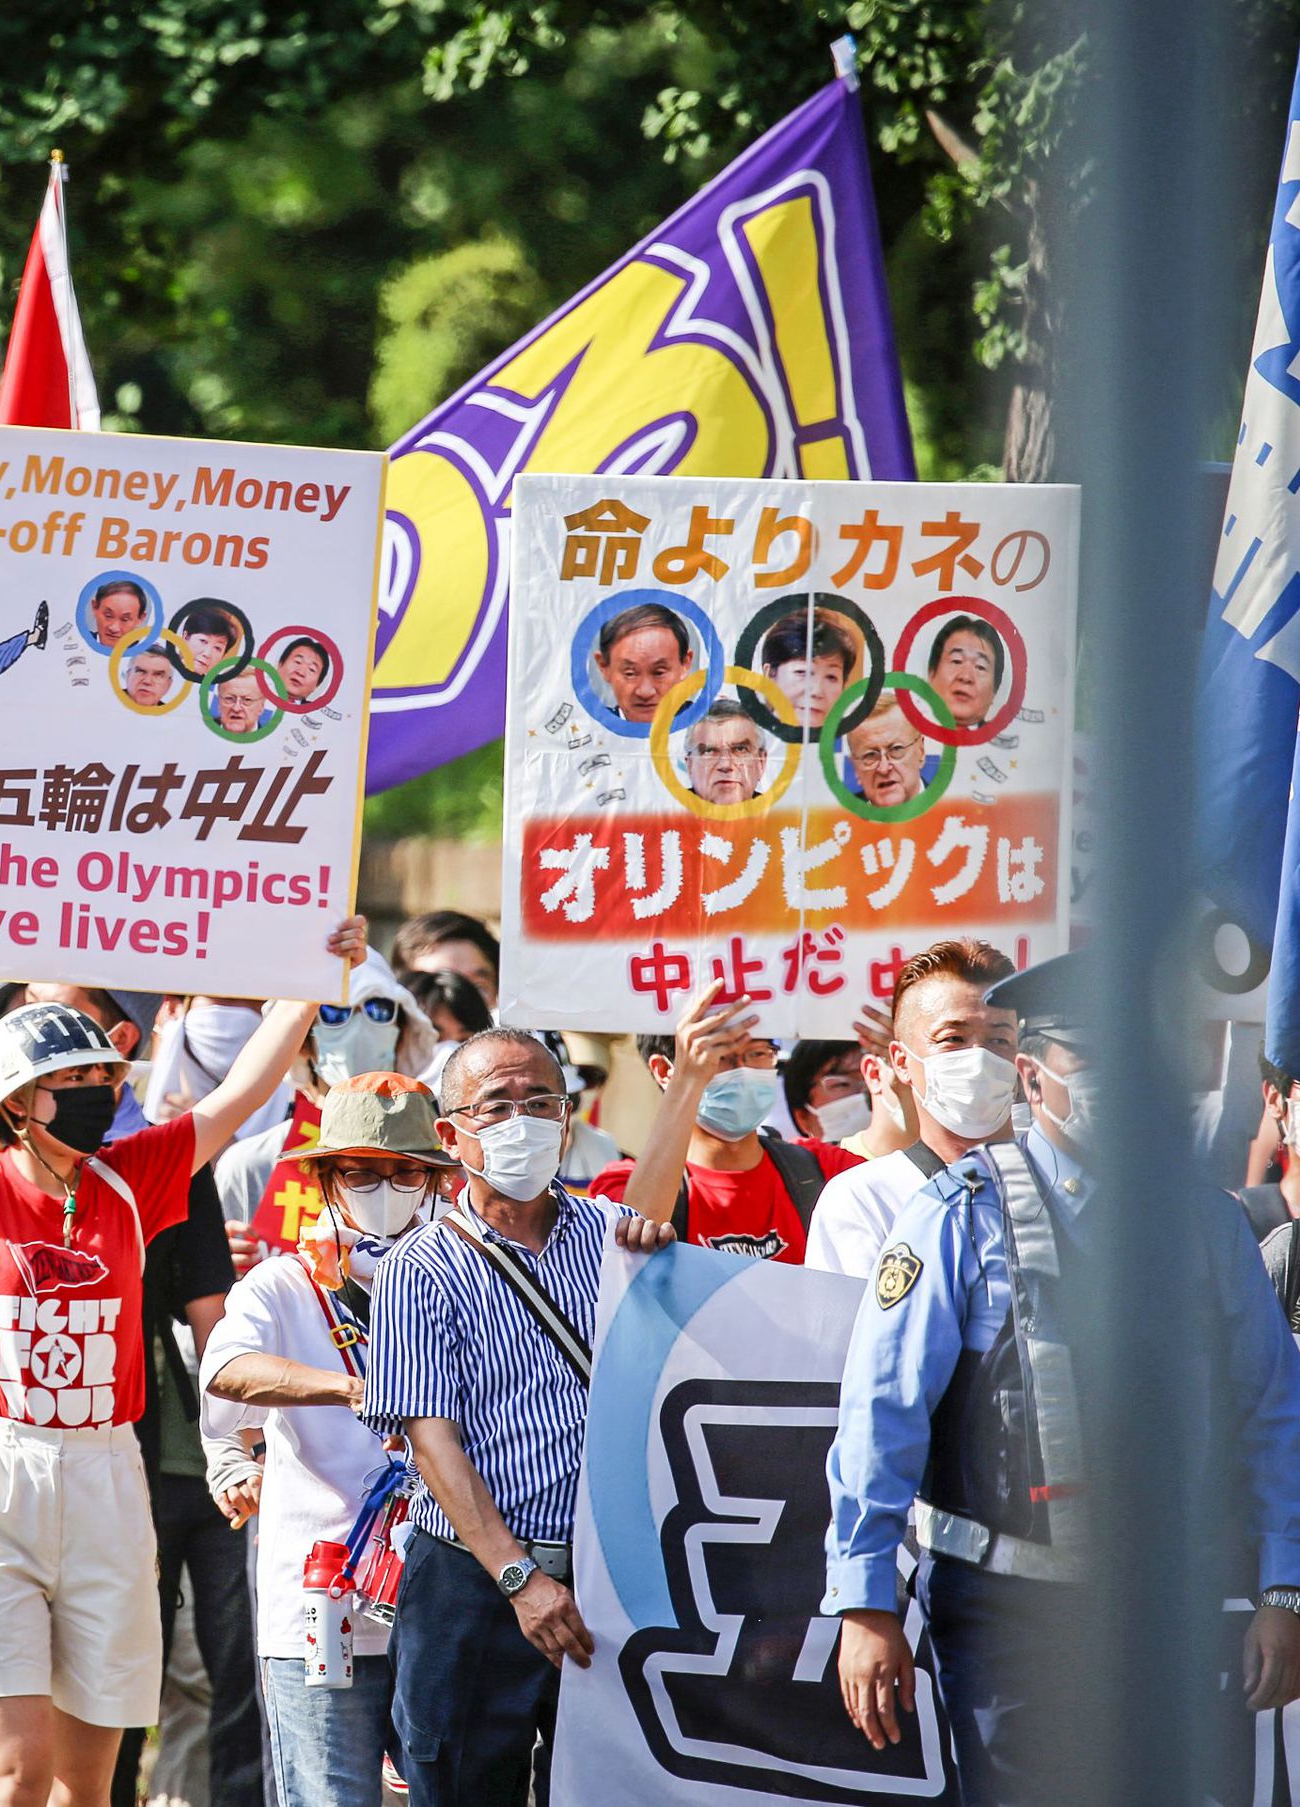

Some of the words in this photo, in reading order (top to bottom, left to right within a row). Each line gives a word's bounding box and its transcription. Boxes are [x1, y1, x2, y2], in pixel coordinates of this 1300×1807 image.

[95, 517, 271, 571] Barons
[559, 498, 1052, 593] 命よりカネの
[77, 851, 331, 910] Olympics!
[538, 815, 1044, 923] オリンピックは
[59, 902, 211, 960] lives!
[2, 1380, 117, 1428] YOUR
